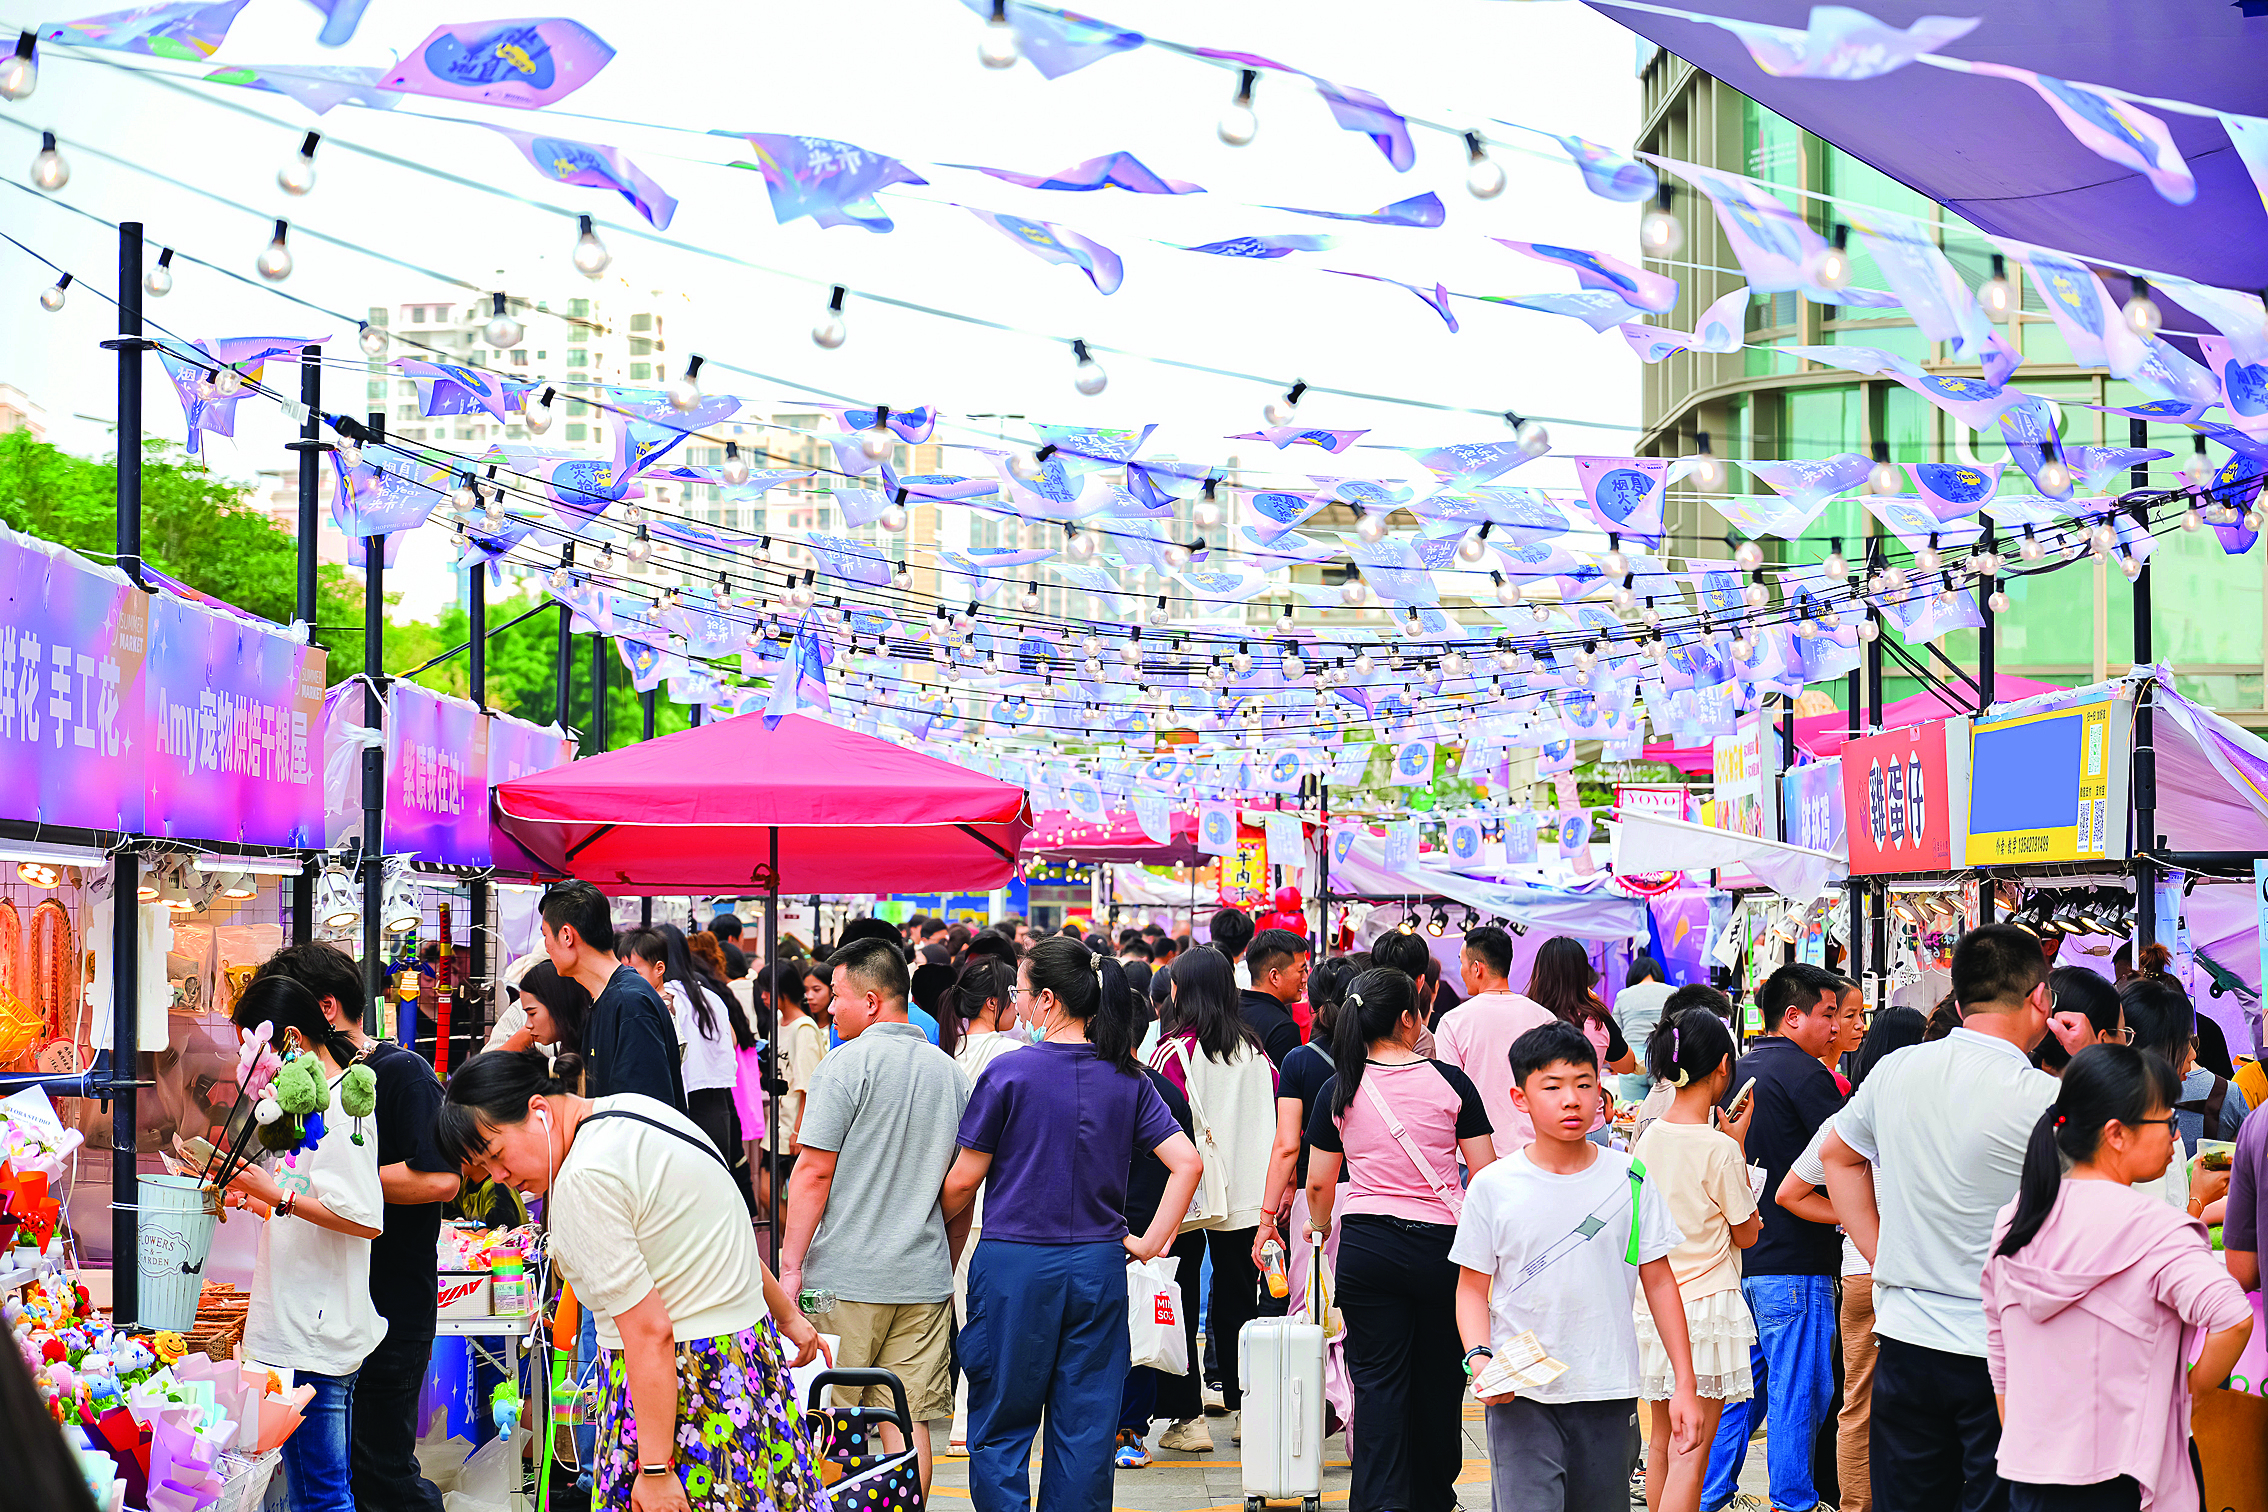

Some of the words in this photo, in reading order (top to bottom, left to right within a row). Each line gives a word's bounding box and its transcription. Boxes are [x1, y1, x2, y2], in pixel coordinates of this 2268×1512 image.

[119, 632, 144, 654] MARKET
[301, 667, 323, 685] SUMMER
[50, 644, 121, 757] 手工花
[301, 684, 323, 701] MARKET
[1629, 793, 1676, 807] YOYO
[1869, 760, 1924, 842] 雞蛋仔
